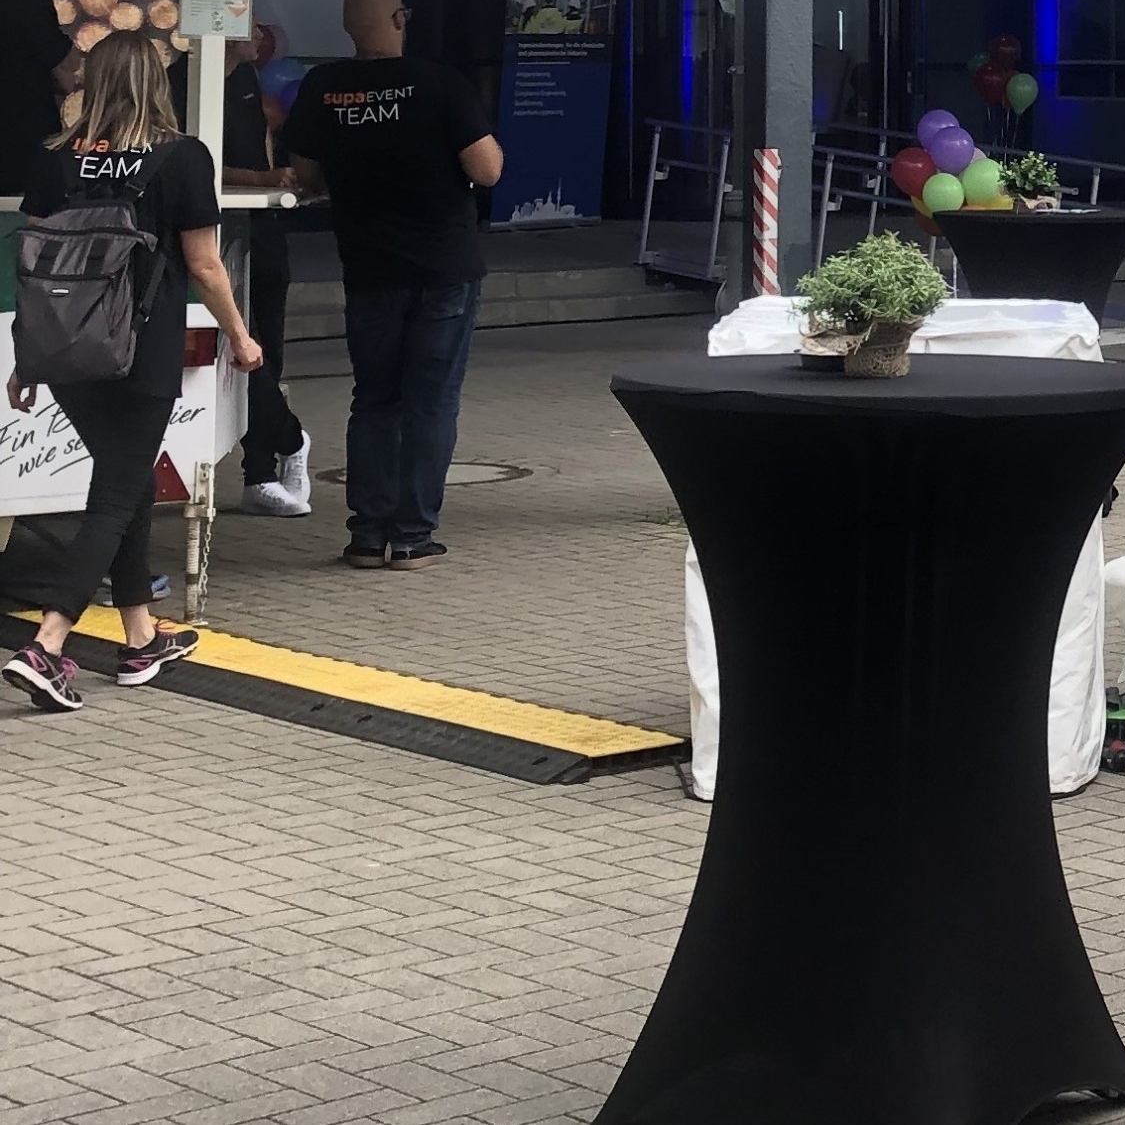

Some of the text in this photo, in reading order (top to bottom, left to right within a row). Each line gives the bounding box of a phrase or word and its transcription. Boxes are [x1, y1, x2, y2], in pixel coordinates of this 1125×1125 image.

[323, 86, 415, 106] supaEVENT
[334, 103, 399, 125] TEAM
[169, 405, 206, 425] ier
[18, 446, 57, 478] wie
